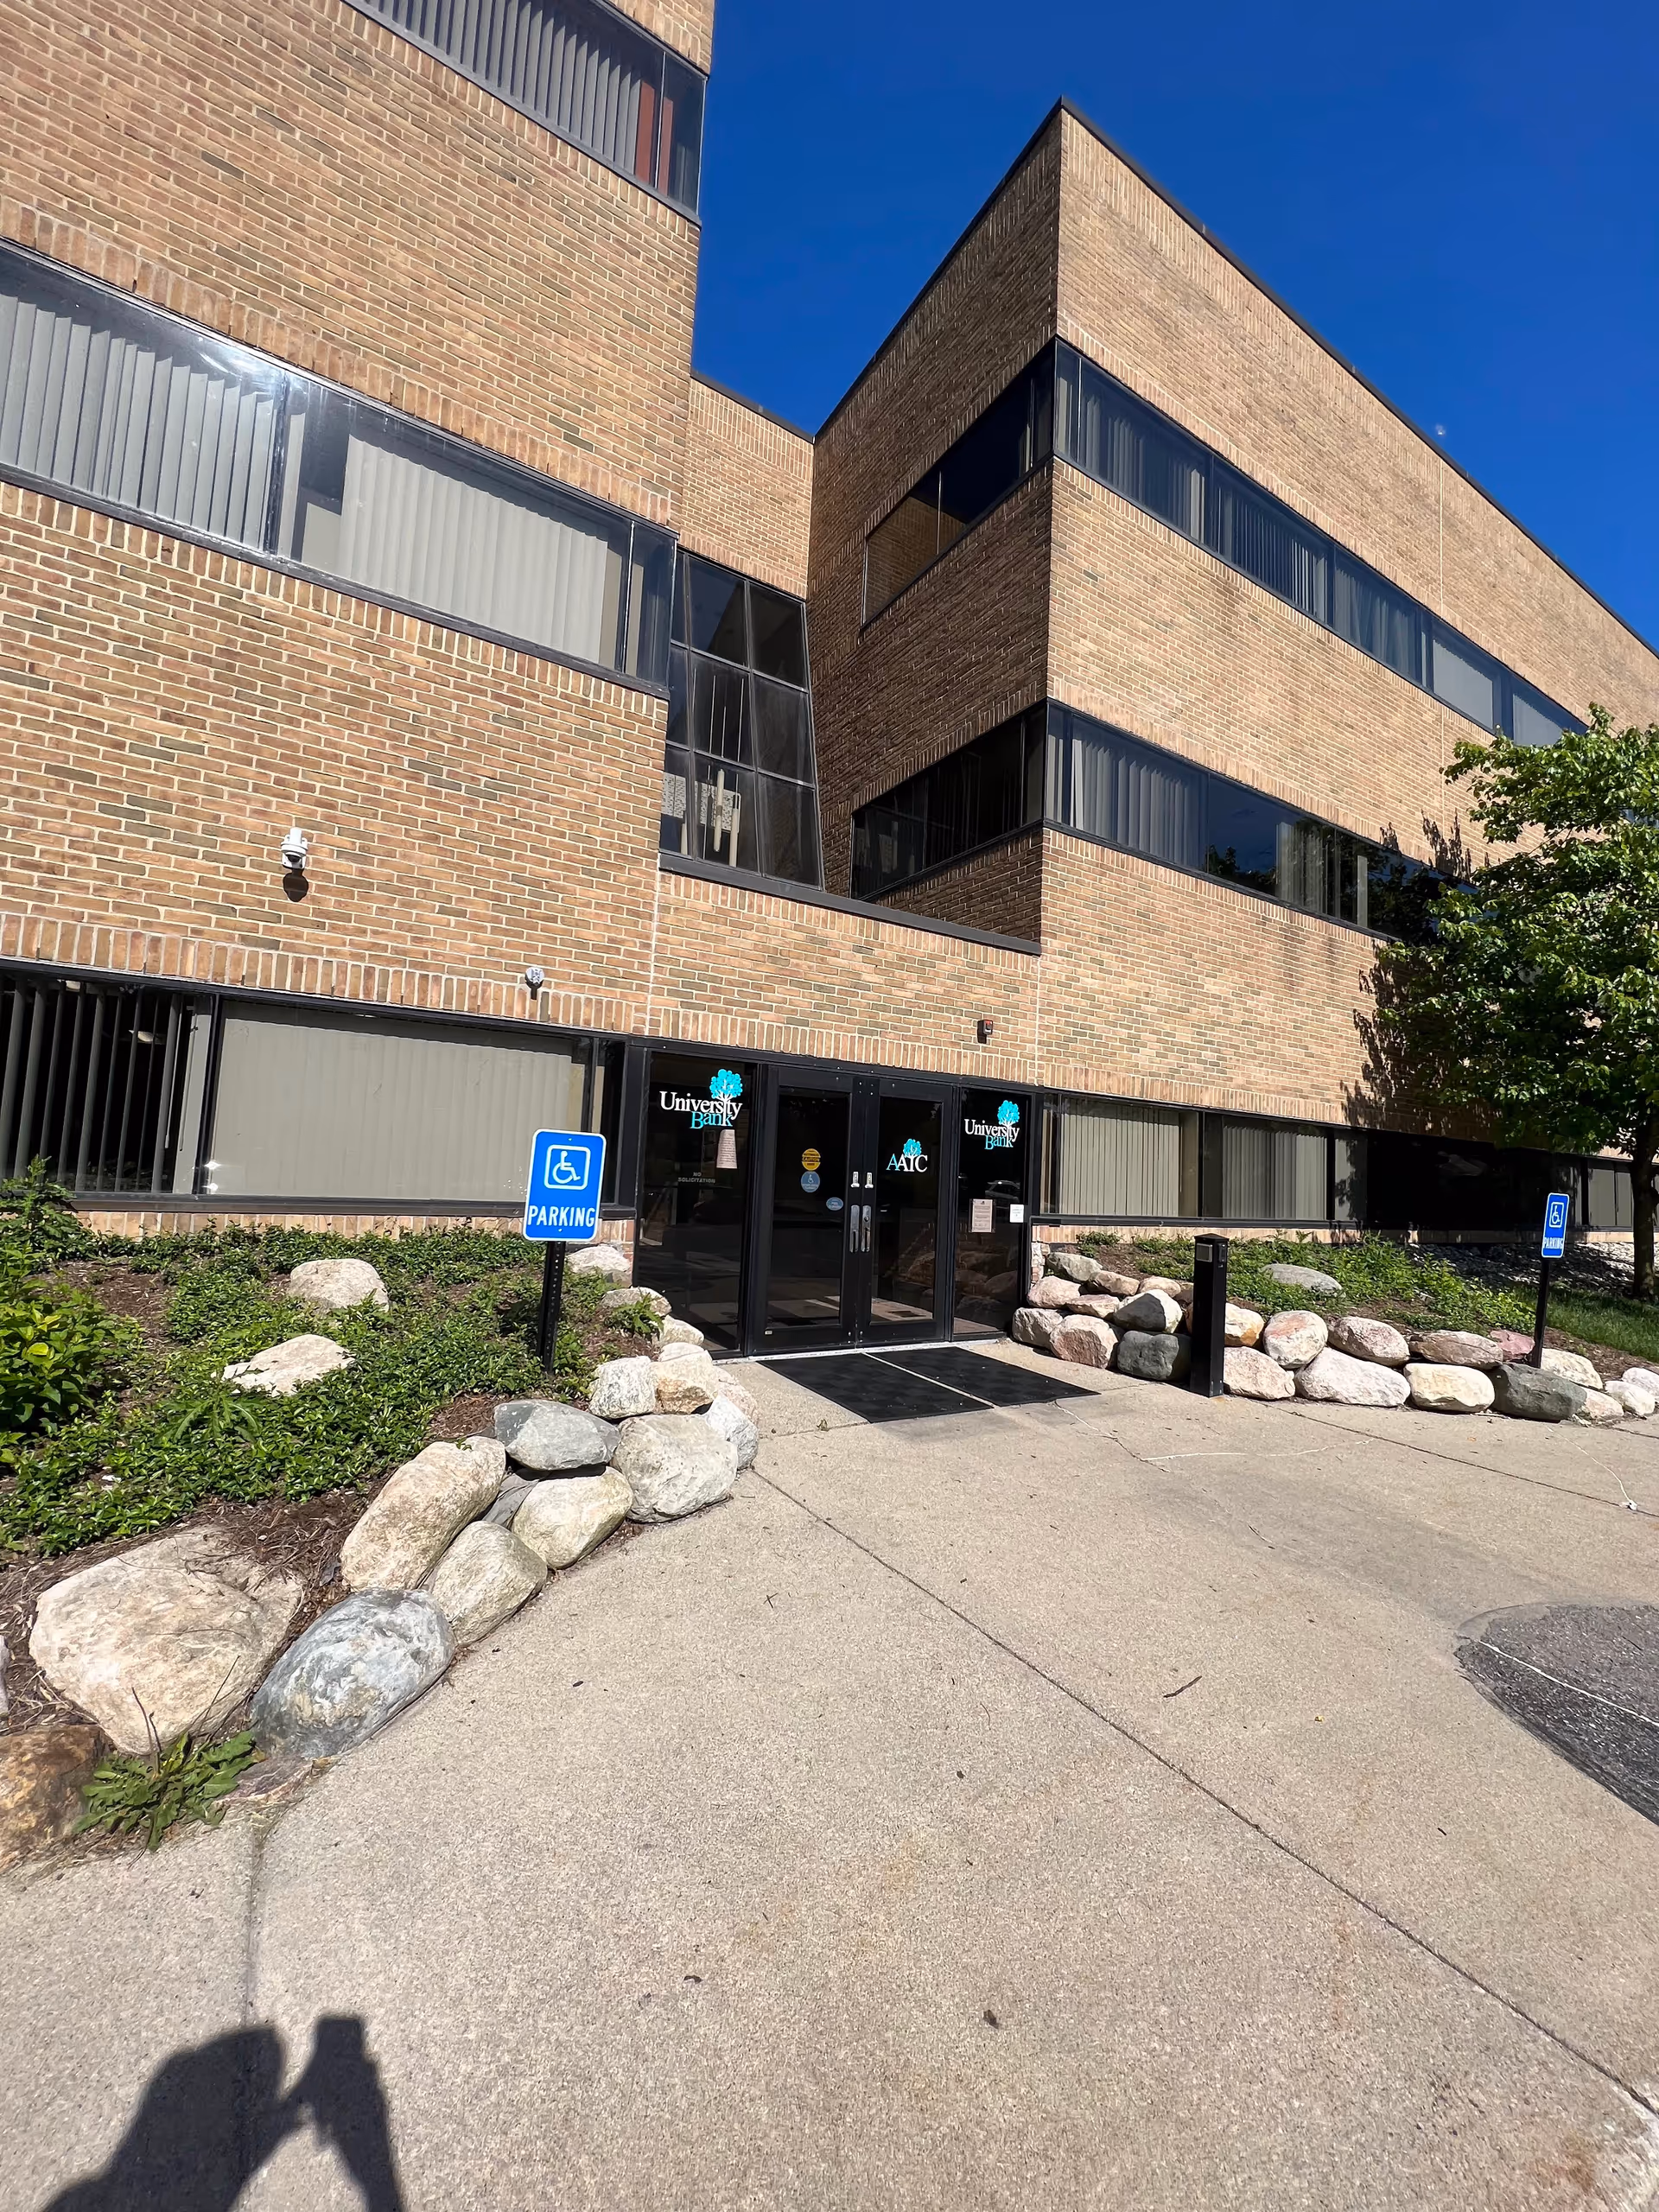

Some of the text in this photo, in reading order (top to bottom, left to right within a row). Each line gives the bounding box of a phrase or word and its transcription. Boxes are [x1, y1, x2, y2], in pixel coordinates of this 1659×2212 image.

[659, 1090, 743, 1120] University
[690, 1111, 733, 1129] Bank
[964, 1119, 1020, 1142] University
[984, 1135, 1014, 1150] Bank
[528, 1205, 595, 1227] PARKING
